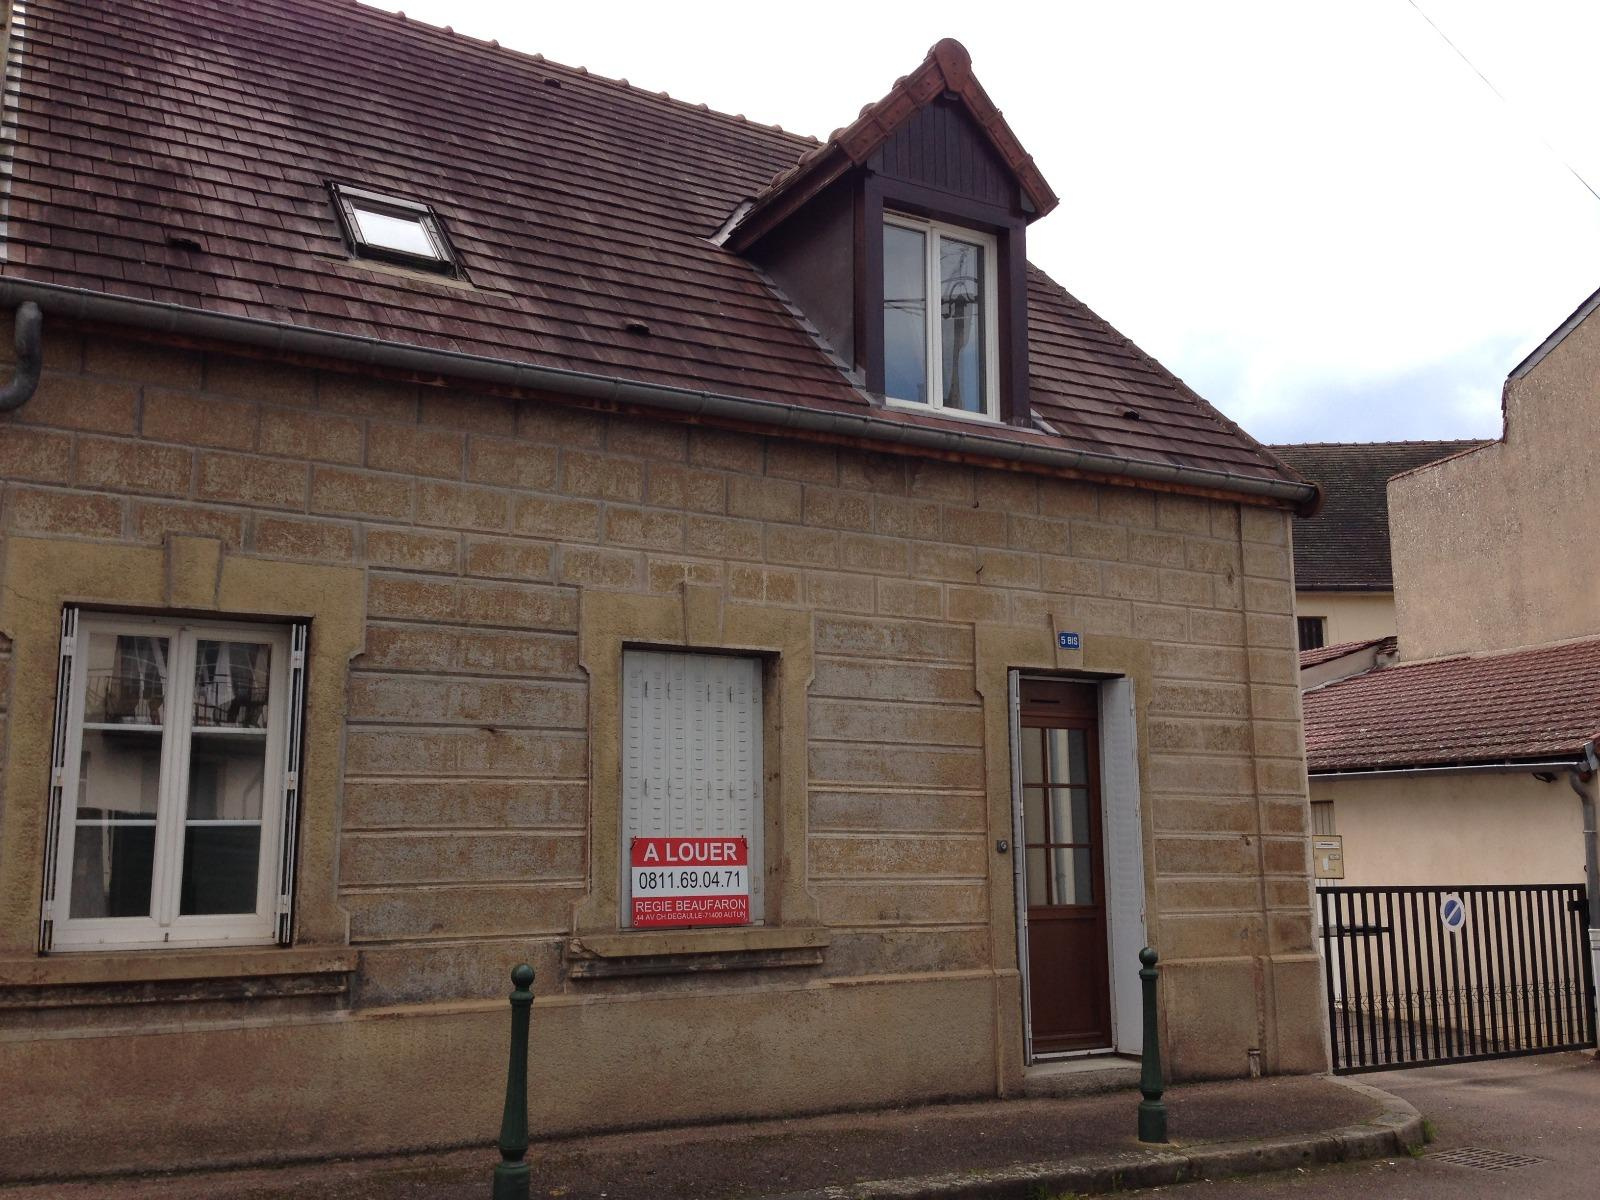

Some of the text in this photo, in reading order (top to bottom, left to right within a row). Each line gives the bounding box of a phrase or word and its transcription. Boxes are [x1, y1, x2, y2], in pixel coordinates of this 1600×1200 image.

[1060, 636, 1078, 645] 5 BIS
[643, 842, 738, 861] A LOUER
[639, 870, 740, 889] 0811.69.04.71
[635, 899, 746, 912] REGIE BEAUFARON
